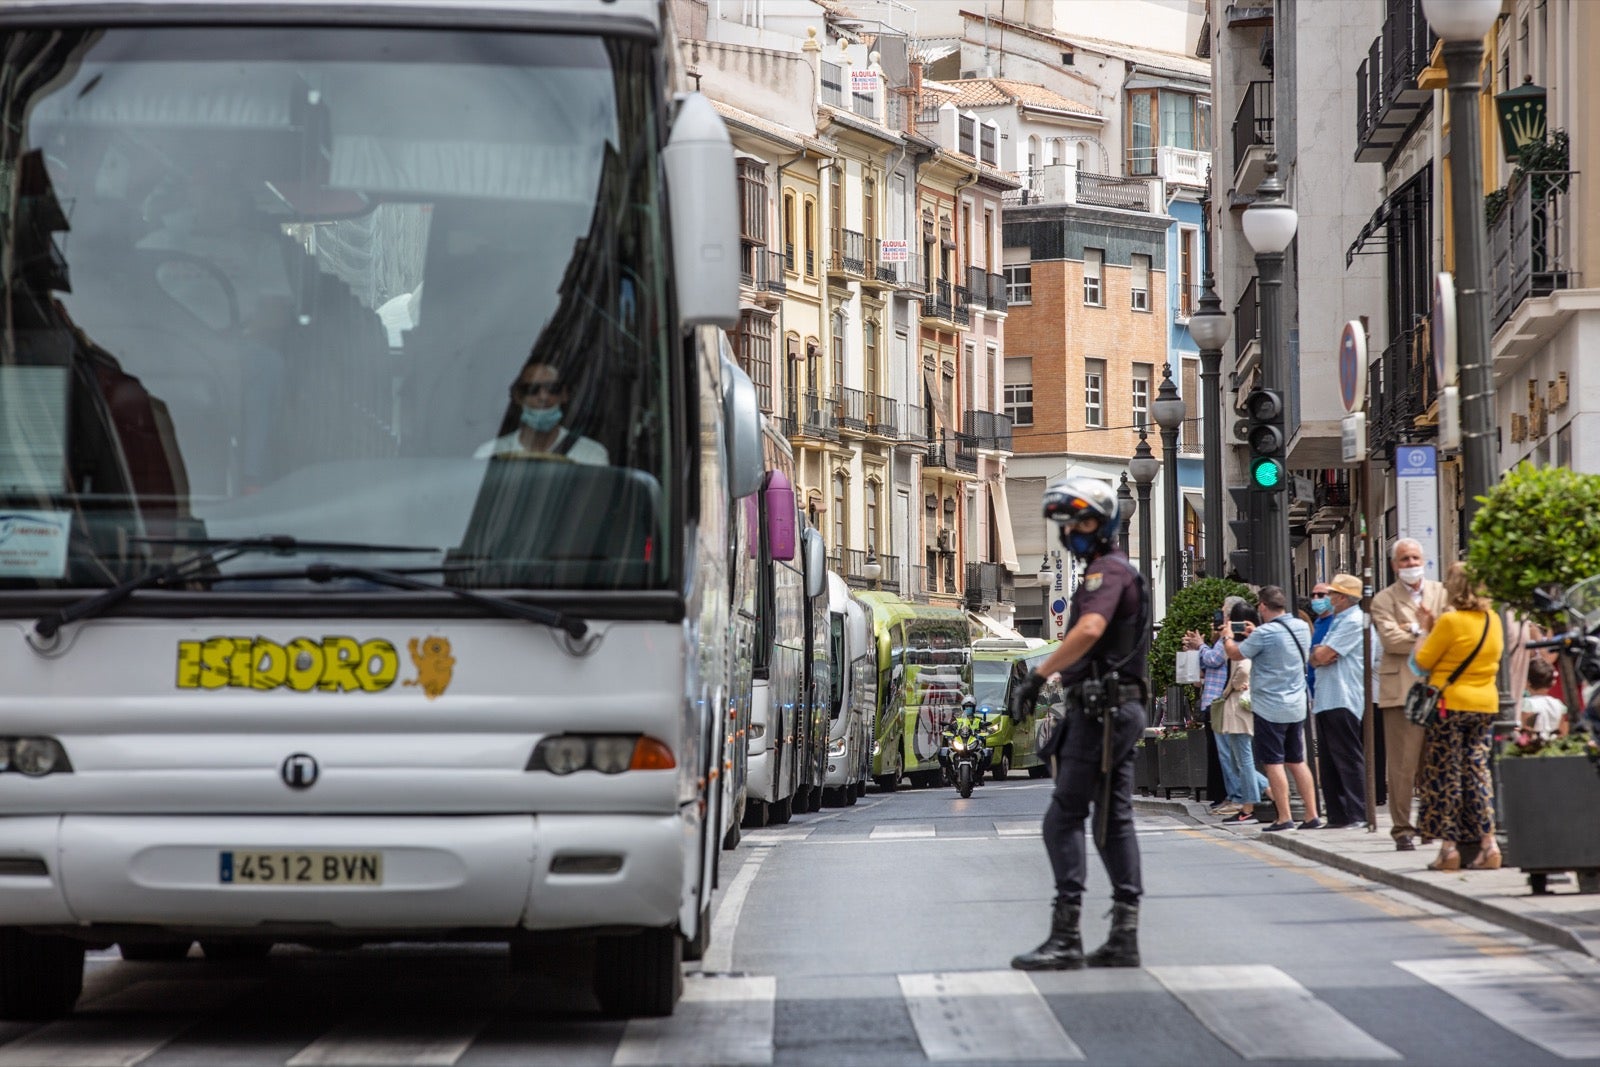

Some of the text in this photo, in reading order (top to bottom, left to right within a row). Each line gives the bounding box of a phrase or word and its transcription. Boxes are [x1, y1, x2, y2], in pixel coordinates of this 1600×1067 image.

[1054, 558, 1063, 591] line.es
[176, 636, 399, 692] ISIDORO
[240, 855, 378, 880] 4512 BVN
